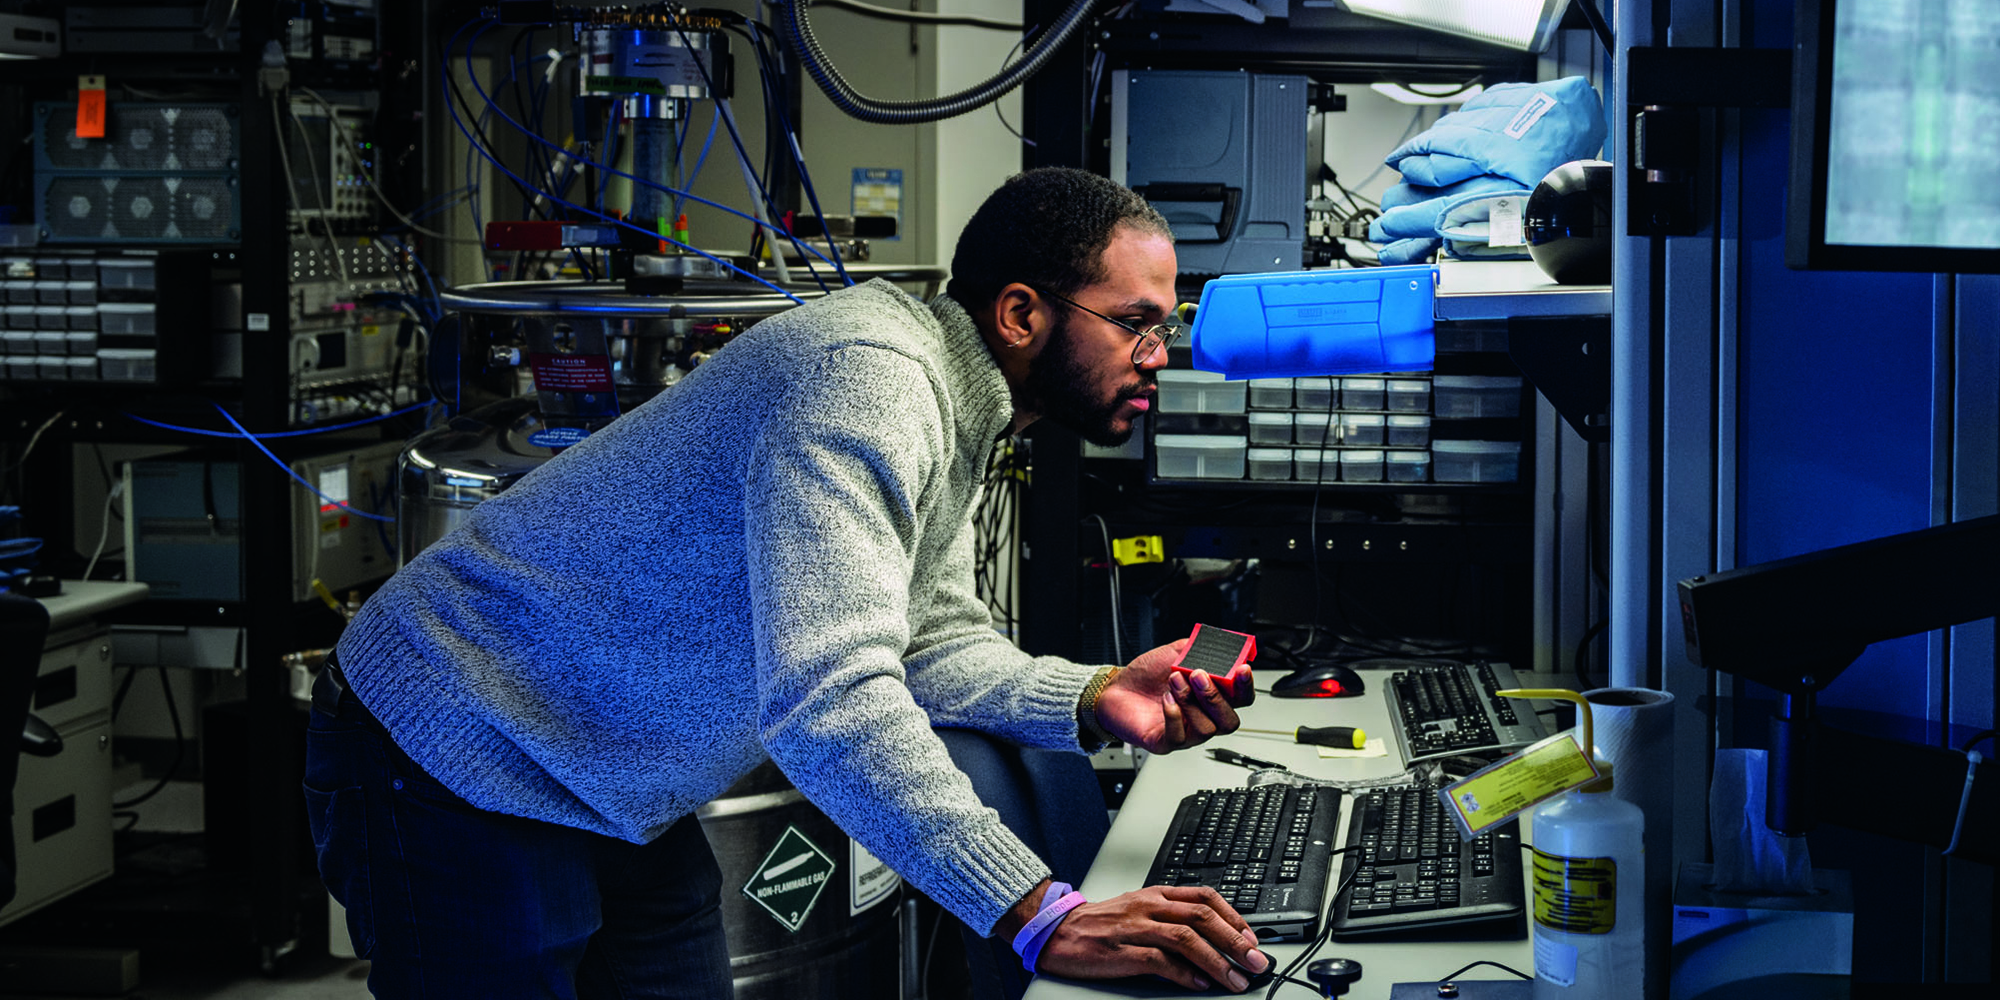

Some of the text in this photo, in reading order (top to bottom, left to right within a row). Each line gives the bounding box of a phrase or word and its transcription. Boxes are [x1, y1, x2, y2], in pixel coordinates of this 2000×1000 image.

[757, 871, 826, 898] NON-FLAMMABLE GAS
[790, 911, 799, 923] 2
[1046, 899, 1072, 918] Hope
